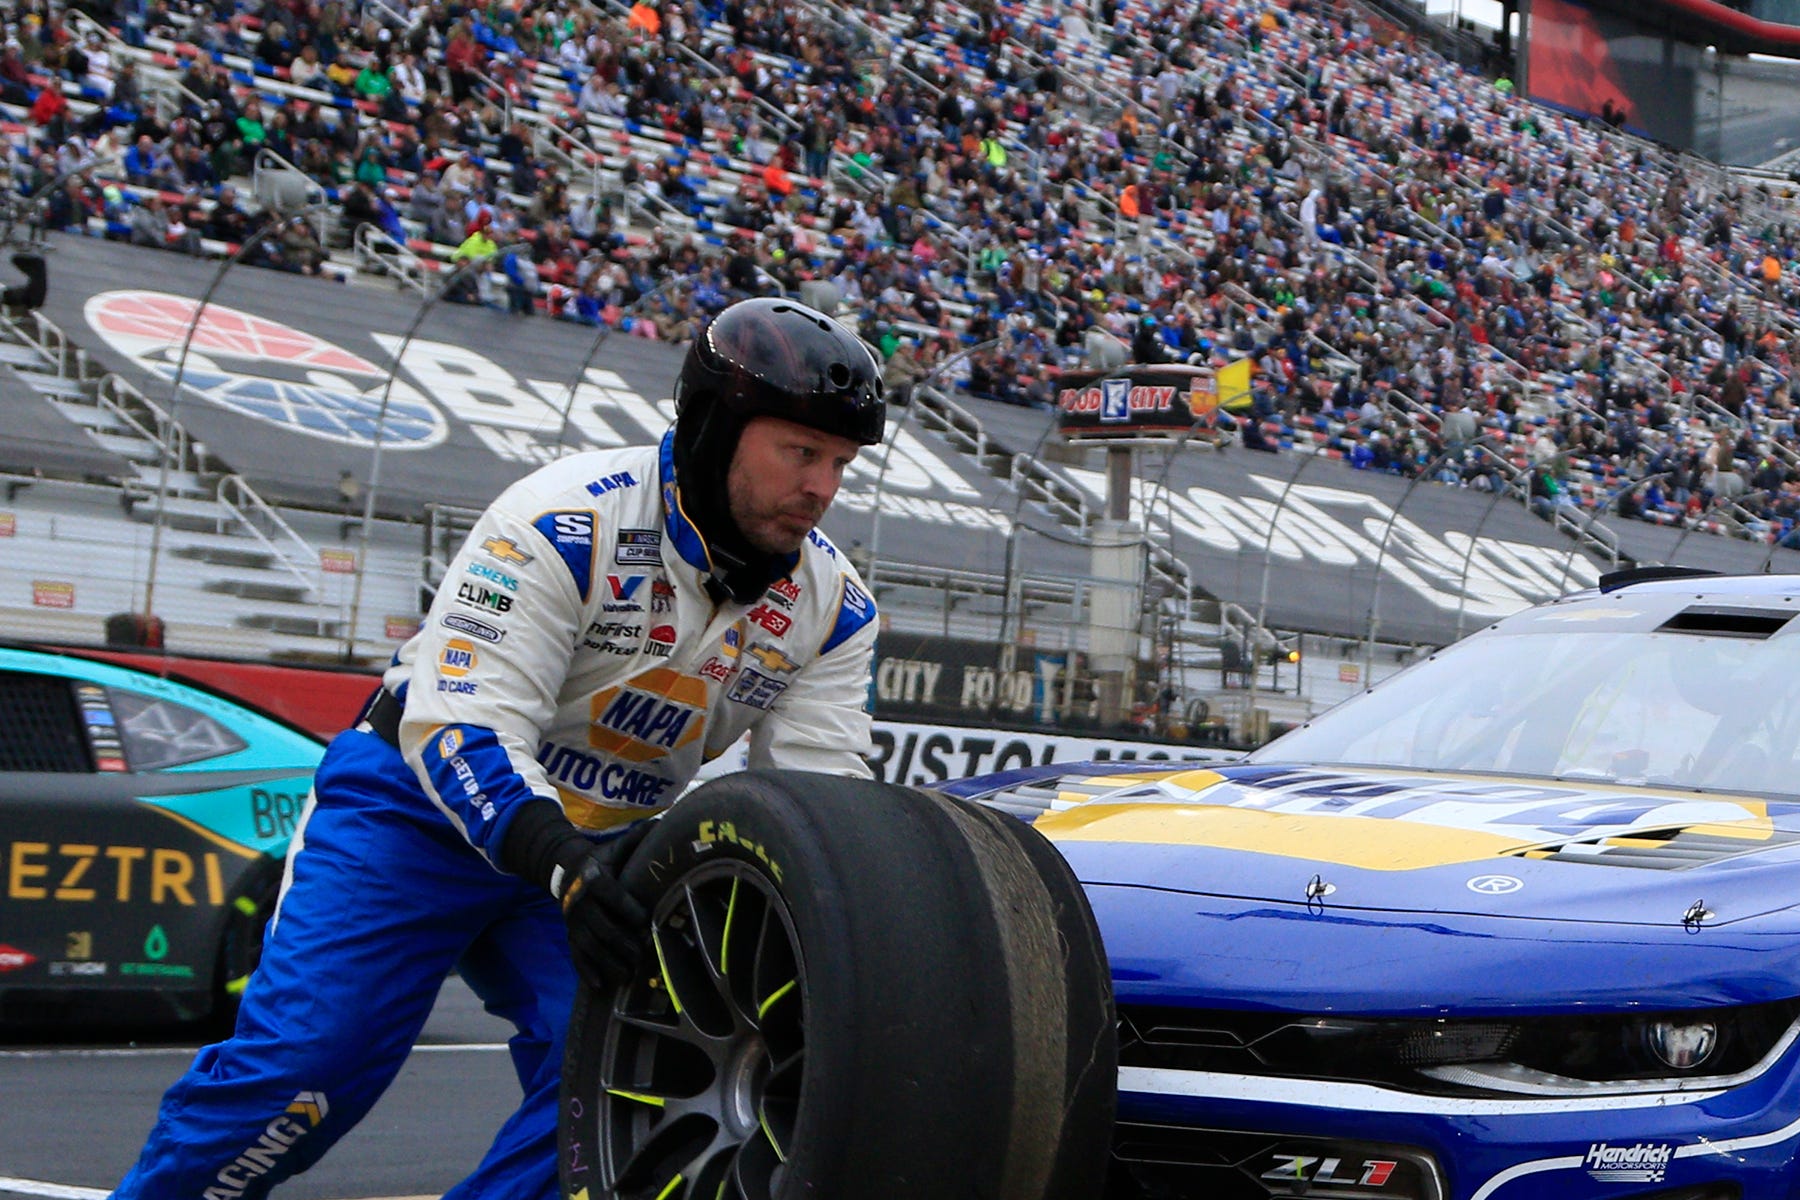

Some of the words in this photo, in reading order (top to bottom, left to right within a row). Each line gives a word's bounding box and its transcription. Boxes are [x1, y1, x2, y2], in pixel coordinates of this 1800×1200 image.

[1129, 386, 1175, 411] CITY
[585, 471, 639, 498] NAPA
[466, 561, 519, 592] SIEMENS
[457, 582, 514, 613] CLIMB
[445, 647, 472, 670] NAPA
[448, 681, 478, 696] CARE
[877, 656, 943, 705] CITY
[961, 665, 1033, 713] FOOD
[601, 690, 694, 748] NAPA
[601, 763, 676, 806] CARE
[250, 787, 312, 840] BR
[1260, 1153, 1398, 1188] ZL1
[1585, 1143, 1673, 1169] Hendrick
[1600, 1162, 1667, 1170] MOTORSPORTS
